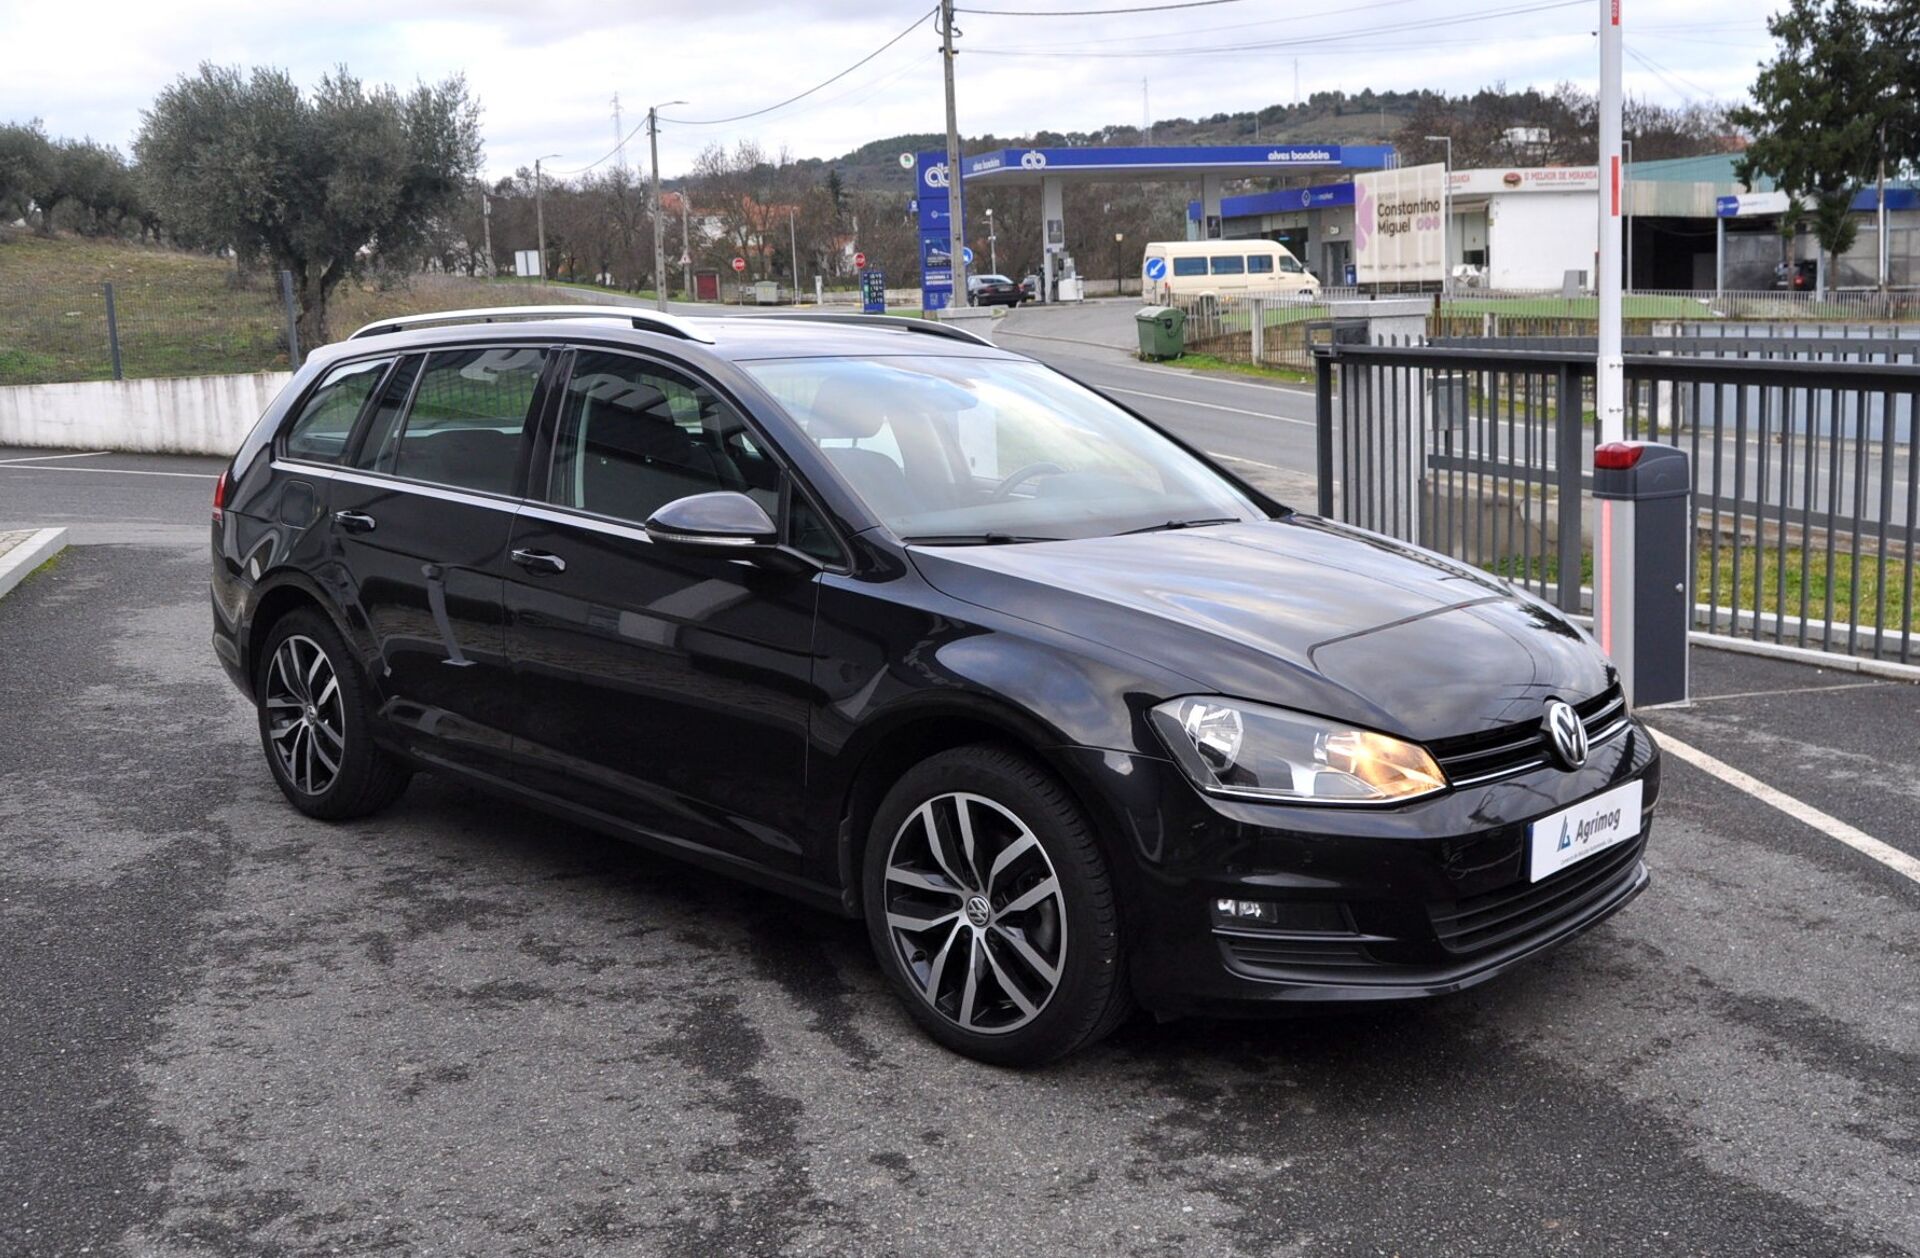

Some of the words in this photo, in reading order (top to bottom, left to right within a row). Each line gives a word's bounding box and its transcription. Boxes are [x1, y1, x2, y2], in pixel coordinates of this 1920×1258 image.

[1377, 197, 1441, 217] Constantino
[1377, 218, 1411, 237] Miguel
[1576, 808, 1621, 844] Agrimog
